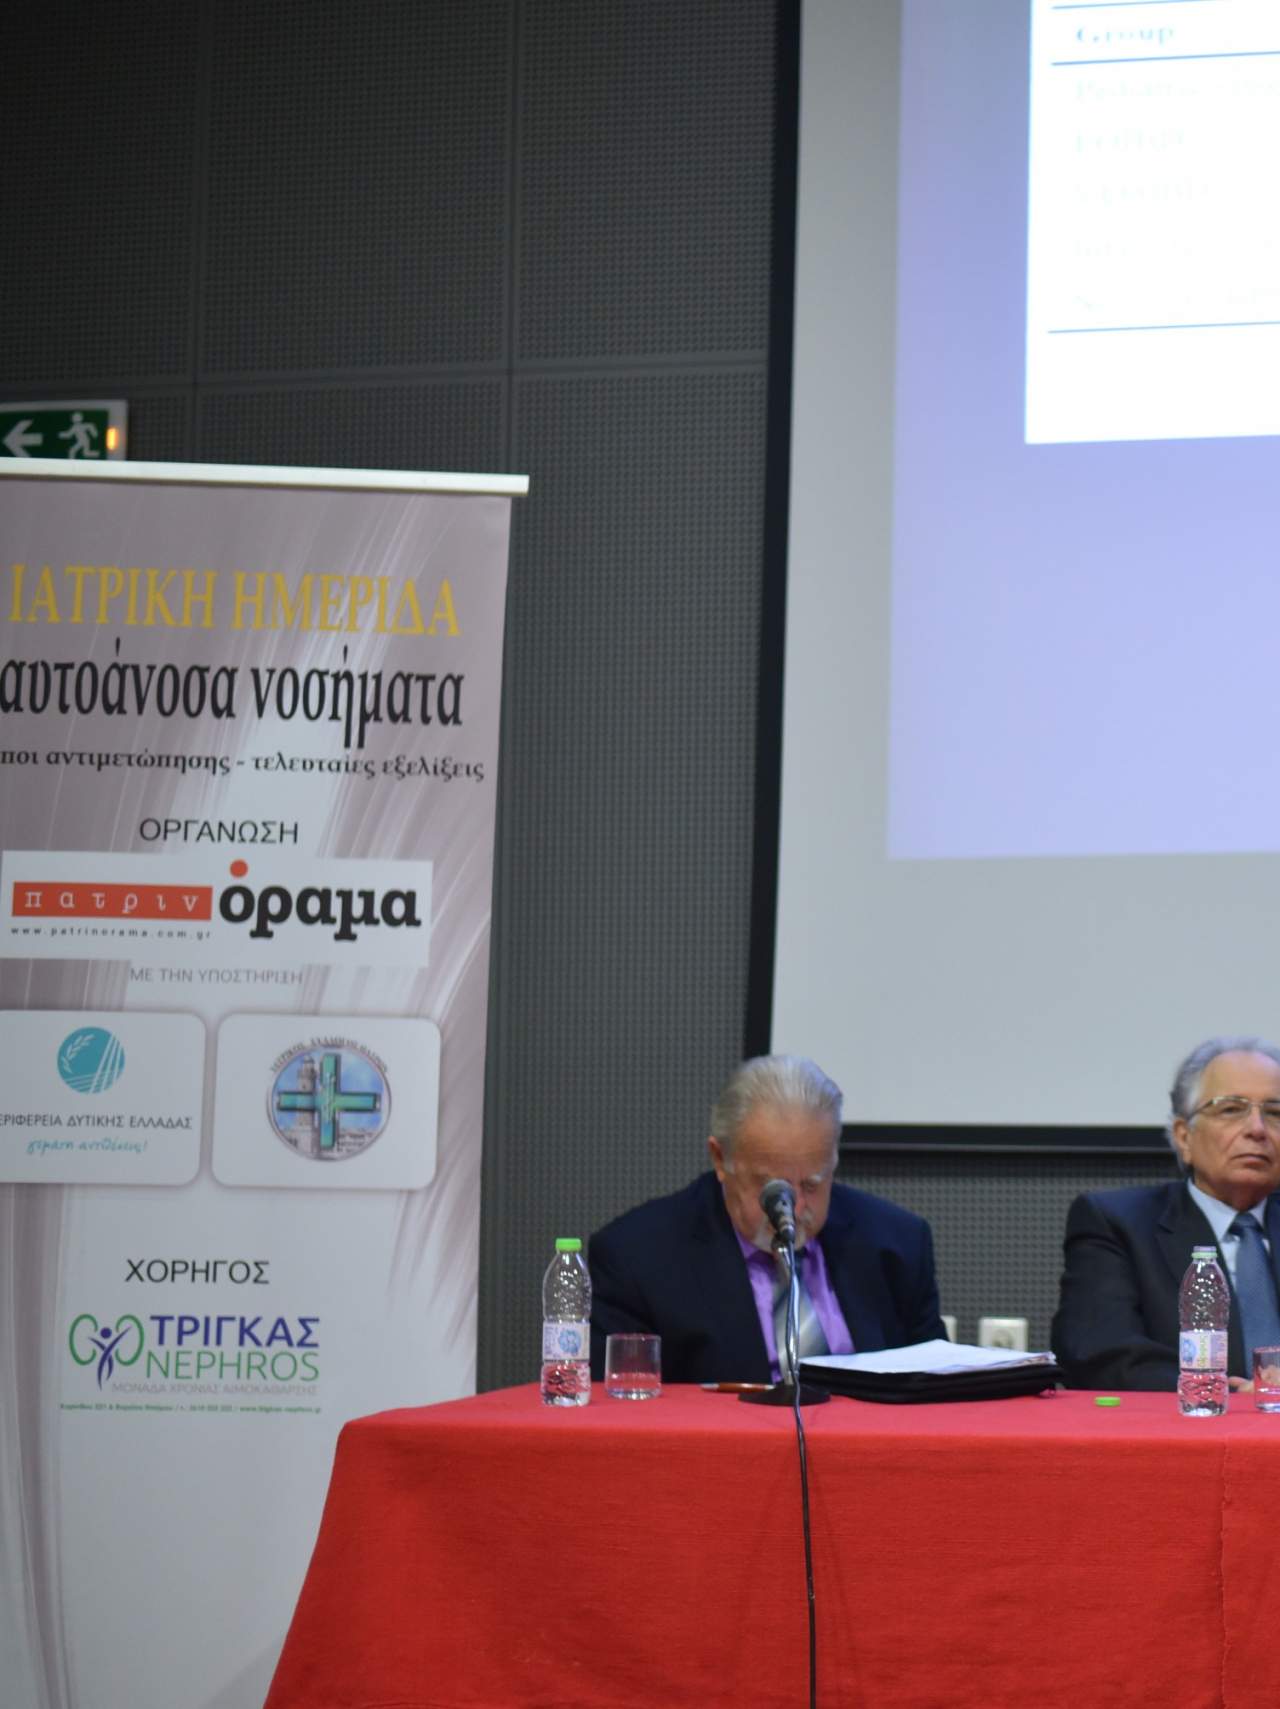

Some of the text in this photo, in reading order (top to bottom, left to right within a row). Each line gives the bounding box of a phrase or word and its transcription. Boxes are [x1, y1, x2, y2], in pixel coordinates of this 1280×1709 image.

[9, 564, 460, 635] ΙΑΤΡΙΚΗ ΗΜΕΡΙΔΑ
[0, 636, 464, 749] αυτοάνοσα νοσήματα
[251, 752, 376, 779] τελευταίες
[382, 757, 485, 782] εξελίξεις
[139, 817, 299, 844] ΟΡΓΑΝΩΣΗ
[130, 967, 153, 982] ΜΕ
[160, 967, 193, 983] ΤΗΝ
[67, 1114, 125, 1128] ΔΥΤΙΚΗΣ
[130, 1116, 193, 1130] ΕΛΛΑΔΑΣ
[125, 1258, 270, 1284] ΧΟΡΗΓΟΣ
[149, 1315, 320, 1348] ΤΡΙΓΚΑΣ
[146, 1350, 319, 1382] NEPHROS
